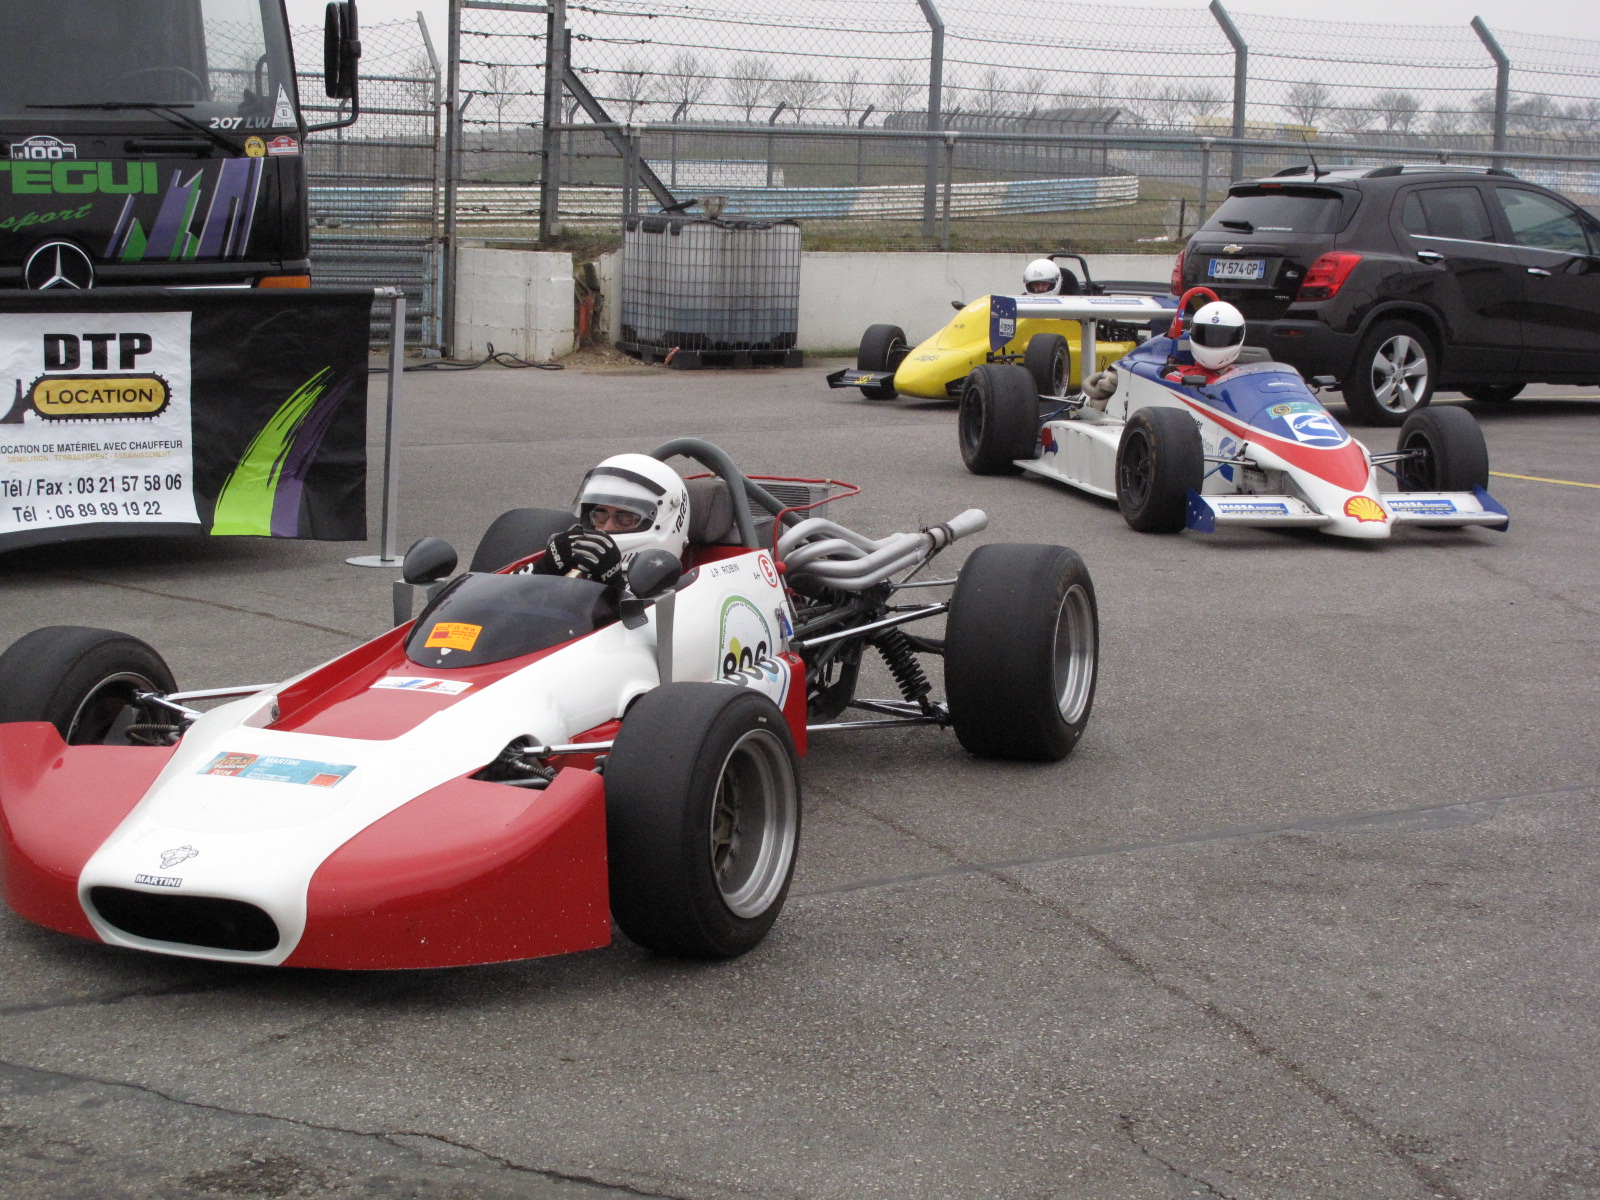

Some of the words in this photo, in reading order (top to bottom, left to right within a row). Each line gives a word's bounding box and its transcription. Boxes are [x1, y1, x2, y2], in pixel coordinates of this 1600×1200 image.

[209, 117, 243, 130] 207
[245, 116, 271, 129] LW
[24, 146, 63, 159] 100
[0, 161, 158, 194] EGUI
[44, 333, 153, 371] DTP
[45, 389, 153, 405] LOCATION
[0, 445, 40, 454] OCATION
[43, 444, 54, 453] DE
[57, 441, 101, 452] MATÉRIEL
[104, 442, 127, 451] AVEC
[129, 440, 183, 450] CHAUFFEUR
[54, 453, 108, 461] TERRASSEMENT
[114, 451, 172, 459] ASSAINISSEMENT
[1, 479, 22, 497] Tél
[27, 479, 32, 496] /
[36, 479, 63, 496] Fax
[77, 477, 95, 494] 03
[99, 476, 115, 493] 21
[122, 475, 139, 492] 57
[144, 475, 161, 491] 58
[165, 474, 182, 491] 06
[12, 506, 37, 522] Tél
[55, 504, 75, 519] 06
[78, 503, 97, 517] 89
[100, 502, 119, 516] 89
[122, 502, 140, 515] 19
[143, 501, 162, 515] 22
[721, 563, 740, 575] ROBIN
[263, 757, 302, 766] MARTINI
[135, 874, 182, 887] MARTINI
